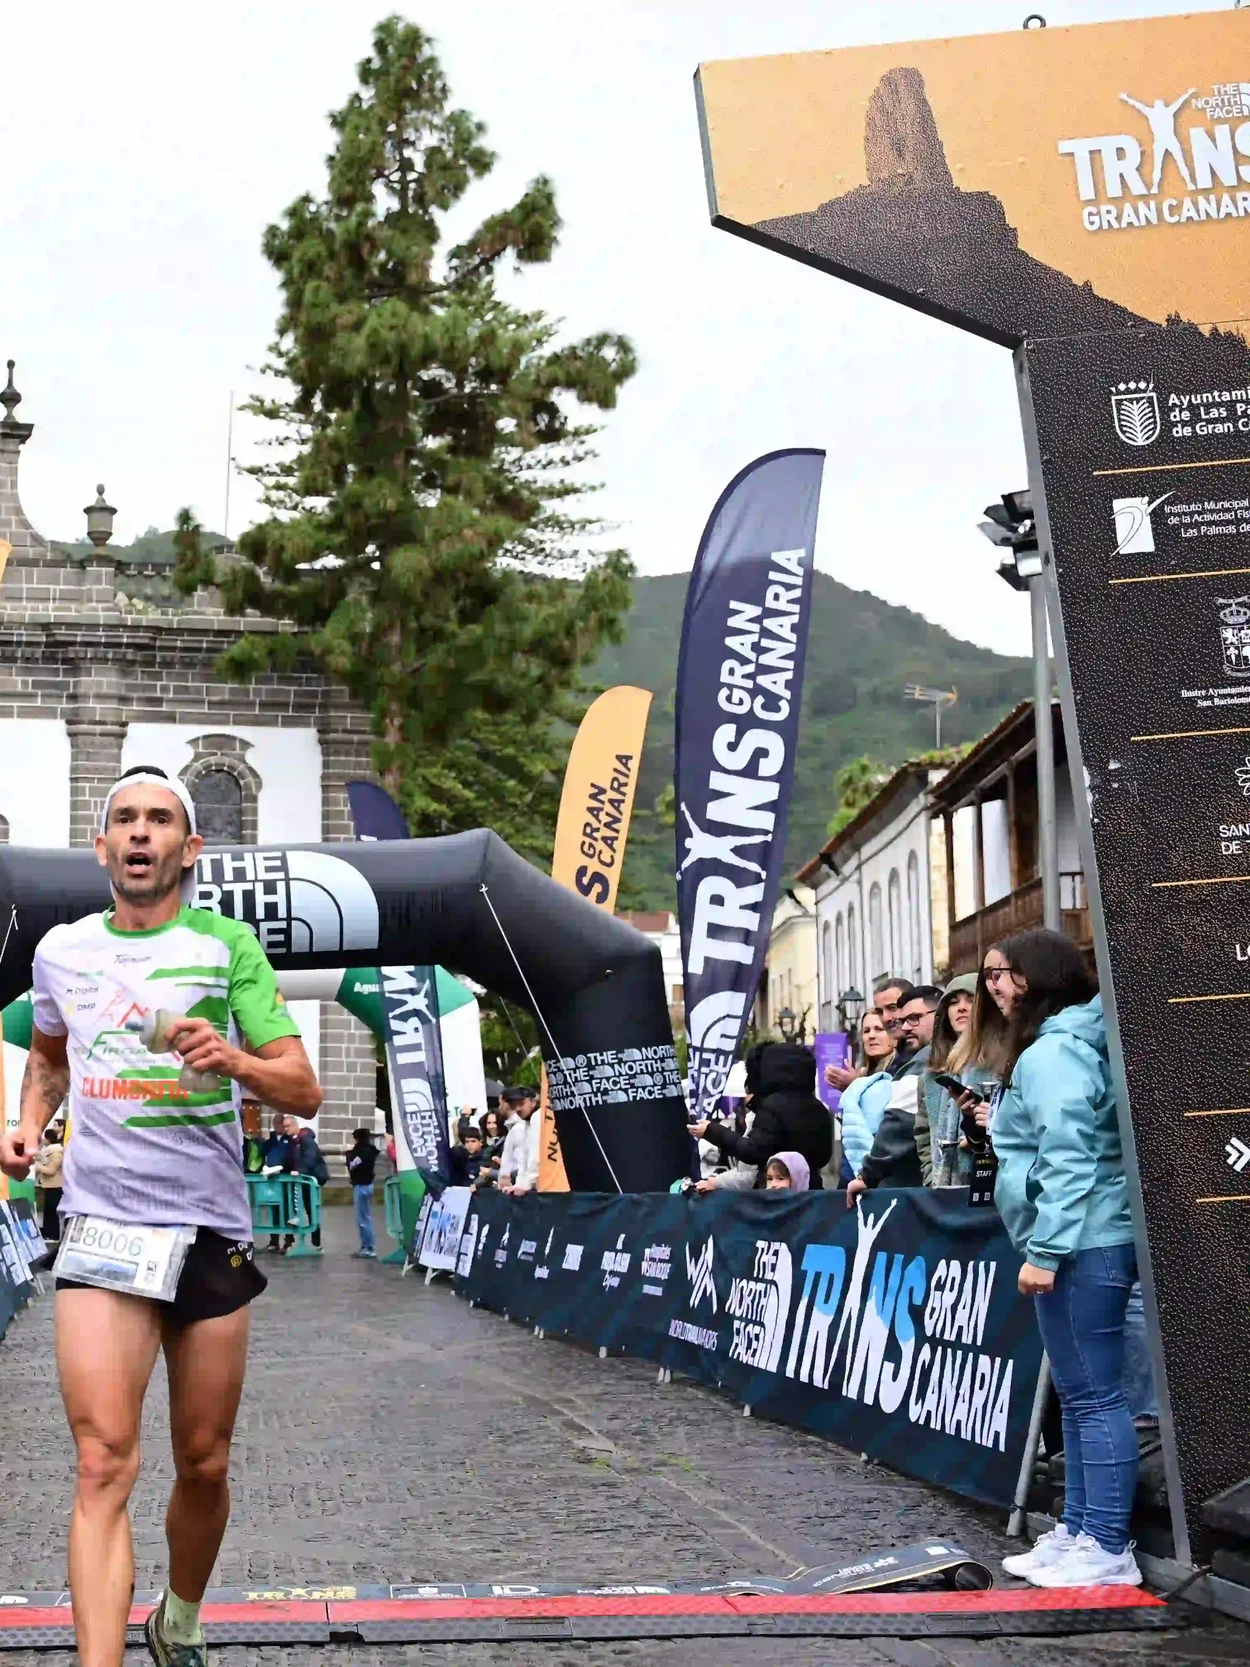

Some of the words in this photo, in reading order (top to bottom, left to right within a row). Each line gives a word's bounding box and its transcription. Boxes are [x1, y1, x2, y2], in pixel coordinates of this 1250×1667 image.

[1191, 94, 1241, 109] NORTH
[1212, 83, 1239, 96] THE
[1206, 105, 1242, 119] FACE
[1082, 199, 1158, 231] GRAN
[1170, 407, 1190, 421] de
[1200, 406, 1227, 419] Las
[1172, 423, 1192, 437] de
[1196, 421, 1233, 435] Gran
[1164, 502, 1202, 514] Instituto
[1204, 499, 1249, 513] Municipal
[1168, 514, 1180, 525] de
[1182, 514, 1190, 524] la
[1192, 510, 1235, 523] Actividad
[1181, 527, 1198, 538] Las
[1200, 524, 1237, 537] Palmas
[753, 548, 806, 722] CANARIA
[717, 600, 763, 715] GRAN
[580, 782, 607, 859] GRAN
[597, 754, 633, 868] CANARIA
[1220, 824, 1250, 837] SAN
[676, 723, 785, 975] TRANS
[1221, 841, 1243, 855] DE
[194, 851, 286, 881] THE
[189, 880, 287, 920] RTH
[1236, 944, 1250, 961] L
[588, 1050, 618, 1066] THE
[563, 1070, 590, 1085] THE
[614, 1060, 661, 1076] NORTH
[592, 1077, 631, 1093] FACE
[663, 1072, 680, 1084] THE
[560, 1094, 603, 1110] NORTH
[628, 1086, 664, 1101] FACE
[976, 1170, 992, 1178] STAFF
[754, 1240, 781, 1280] THE
[725, 1277, 771, 1323] NORTH
[785, 1194, 927, 1414] TRANS
[924, 1259, 997, 1346] GRAN
[729, 1320, 762, 1366] FACE
[909, 1344, 1014, 1452] CANARIA
